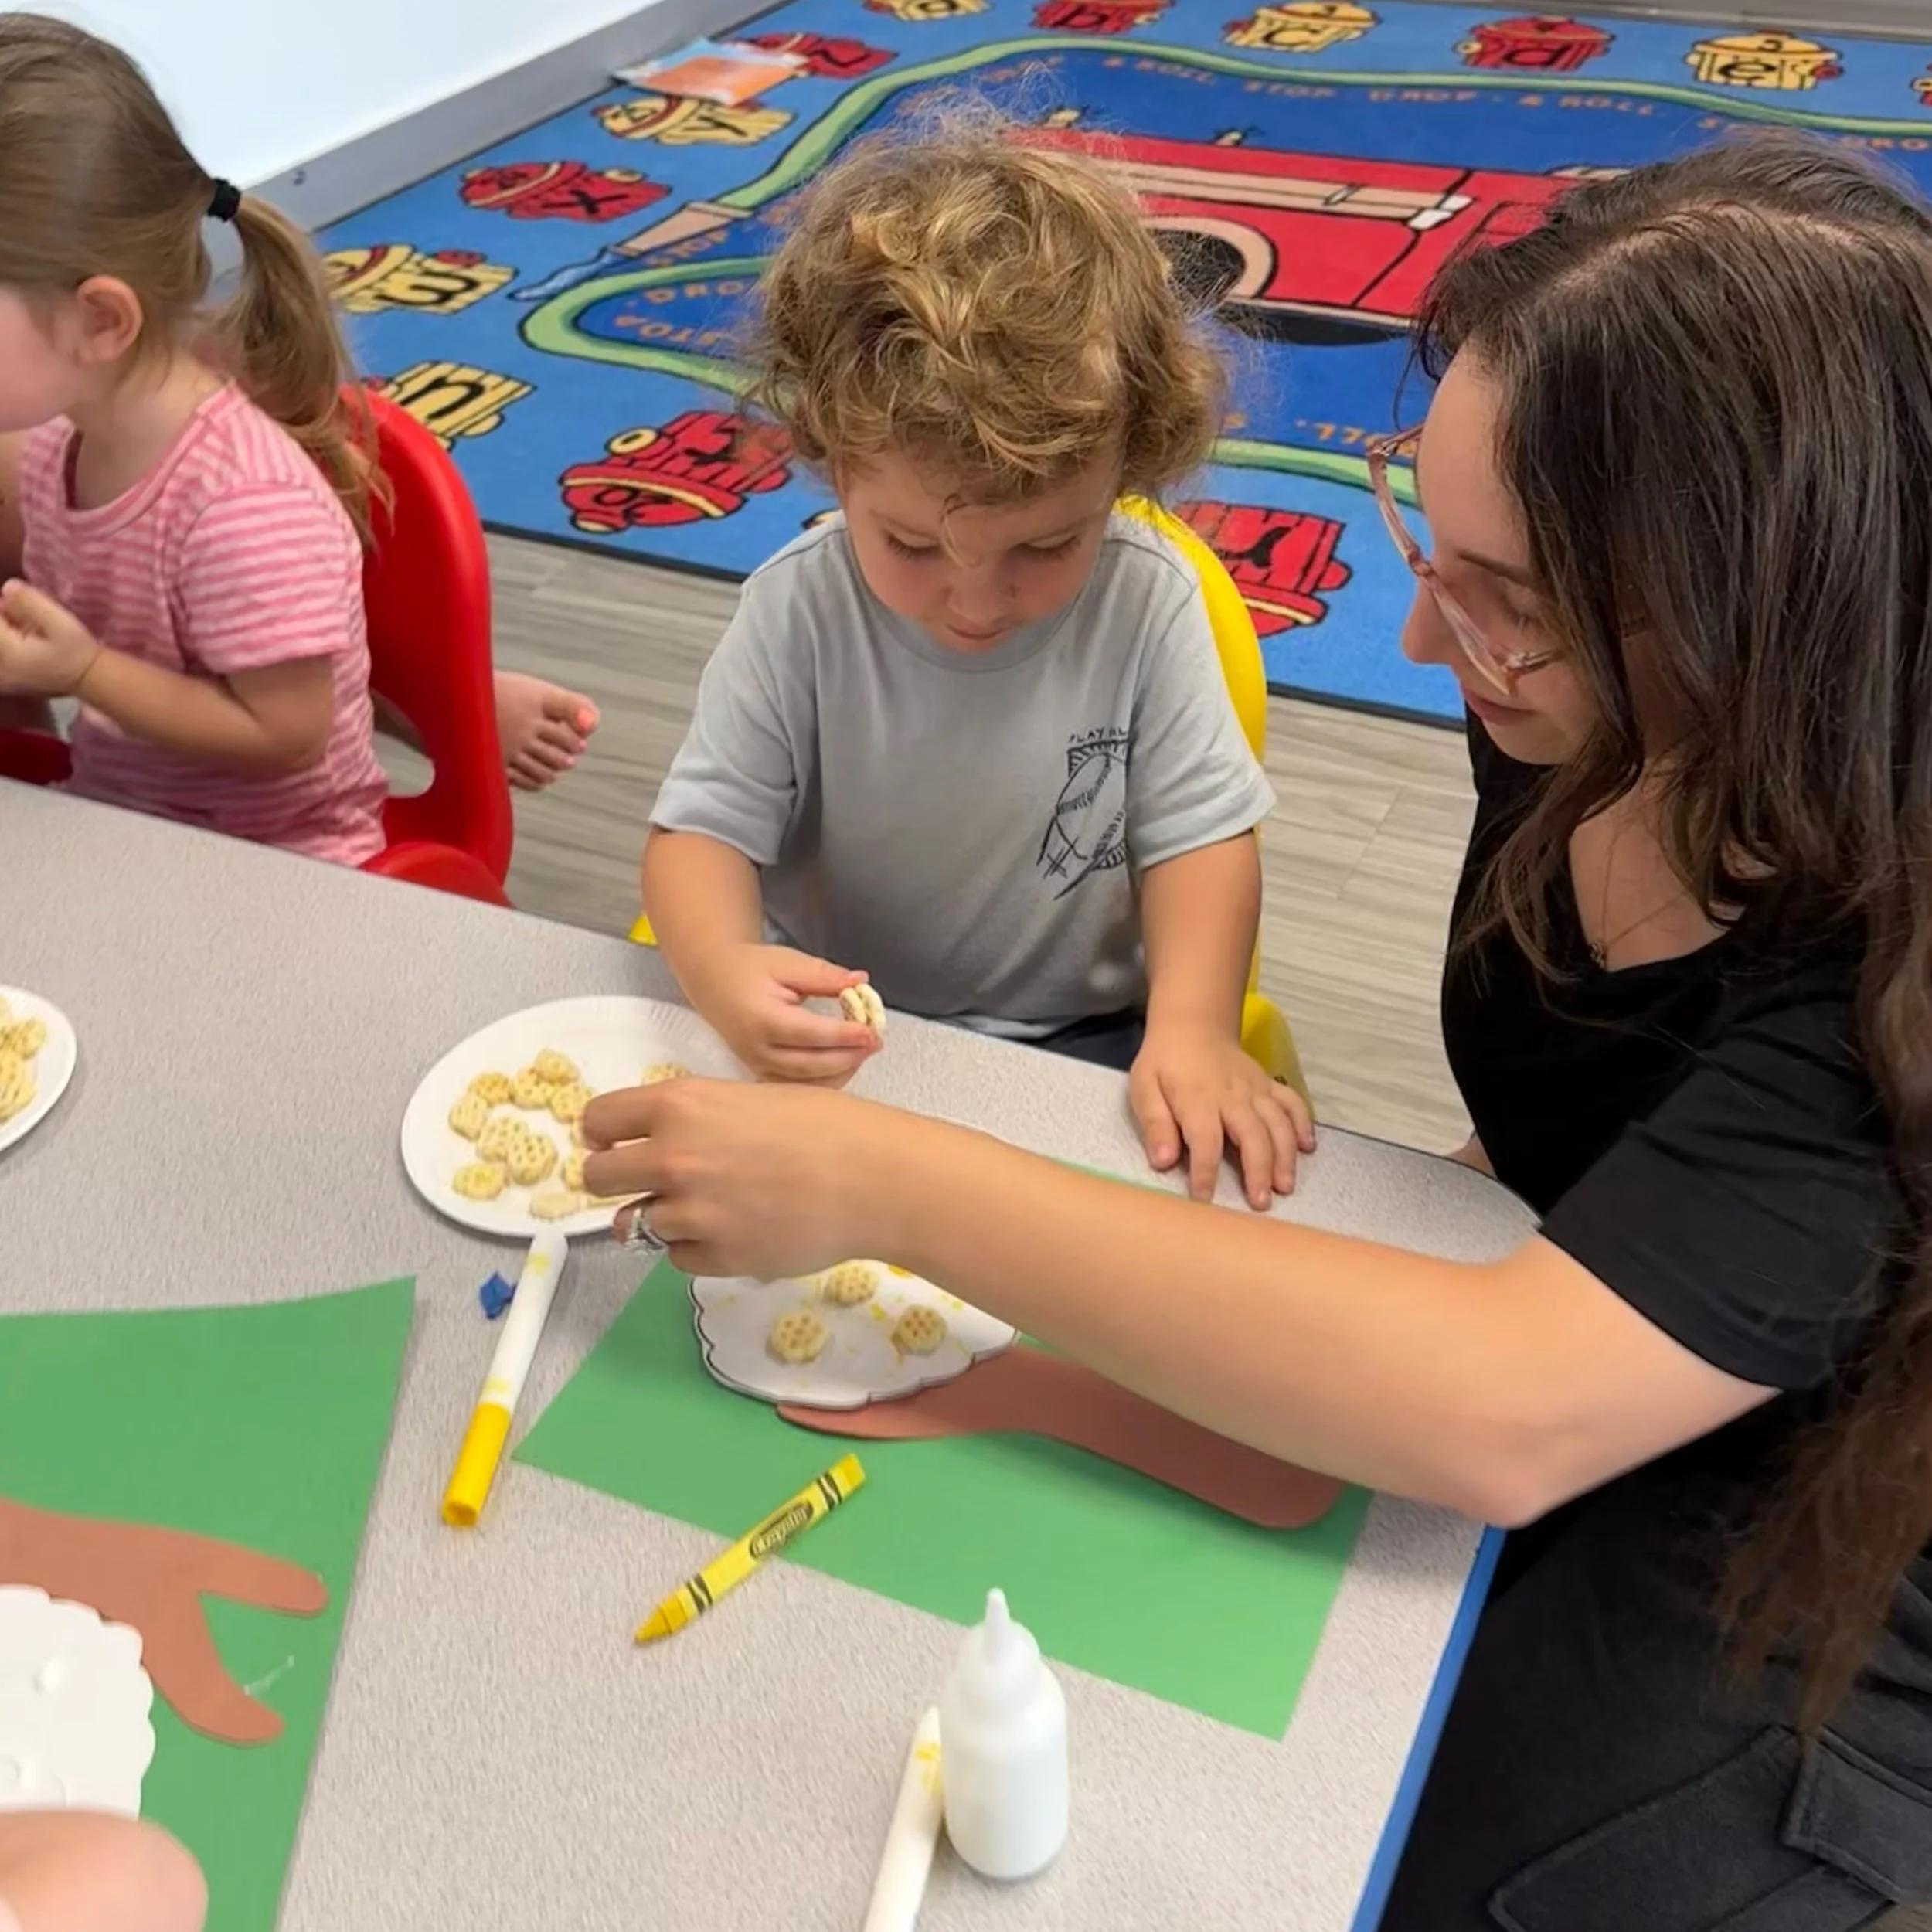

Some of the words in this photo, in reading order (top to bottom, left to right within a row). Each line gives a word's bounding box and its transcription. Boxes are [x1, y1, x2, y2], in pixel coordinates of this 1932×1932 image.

[1262, 26, 1321, 46] c
[1502, 43, 1572, 66] d
[1717, 62, 1777, 80] e
